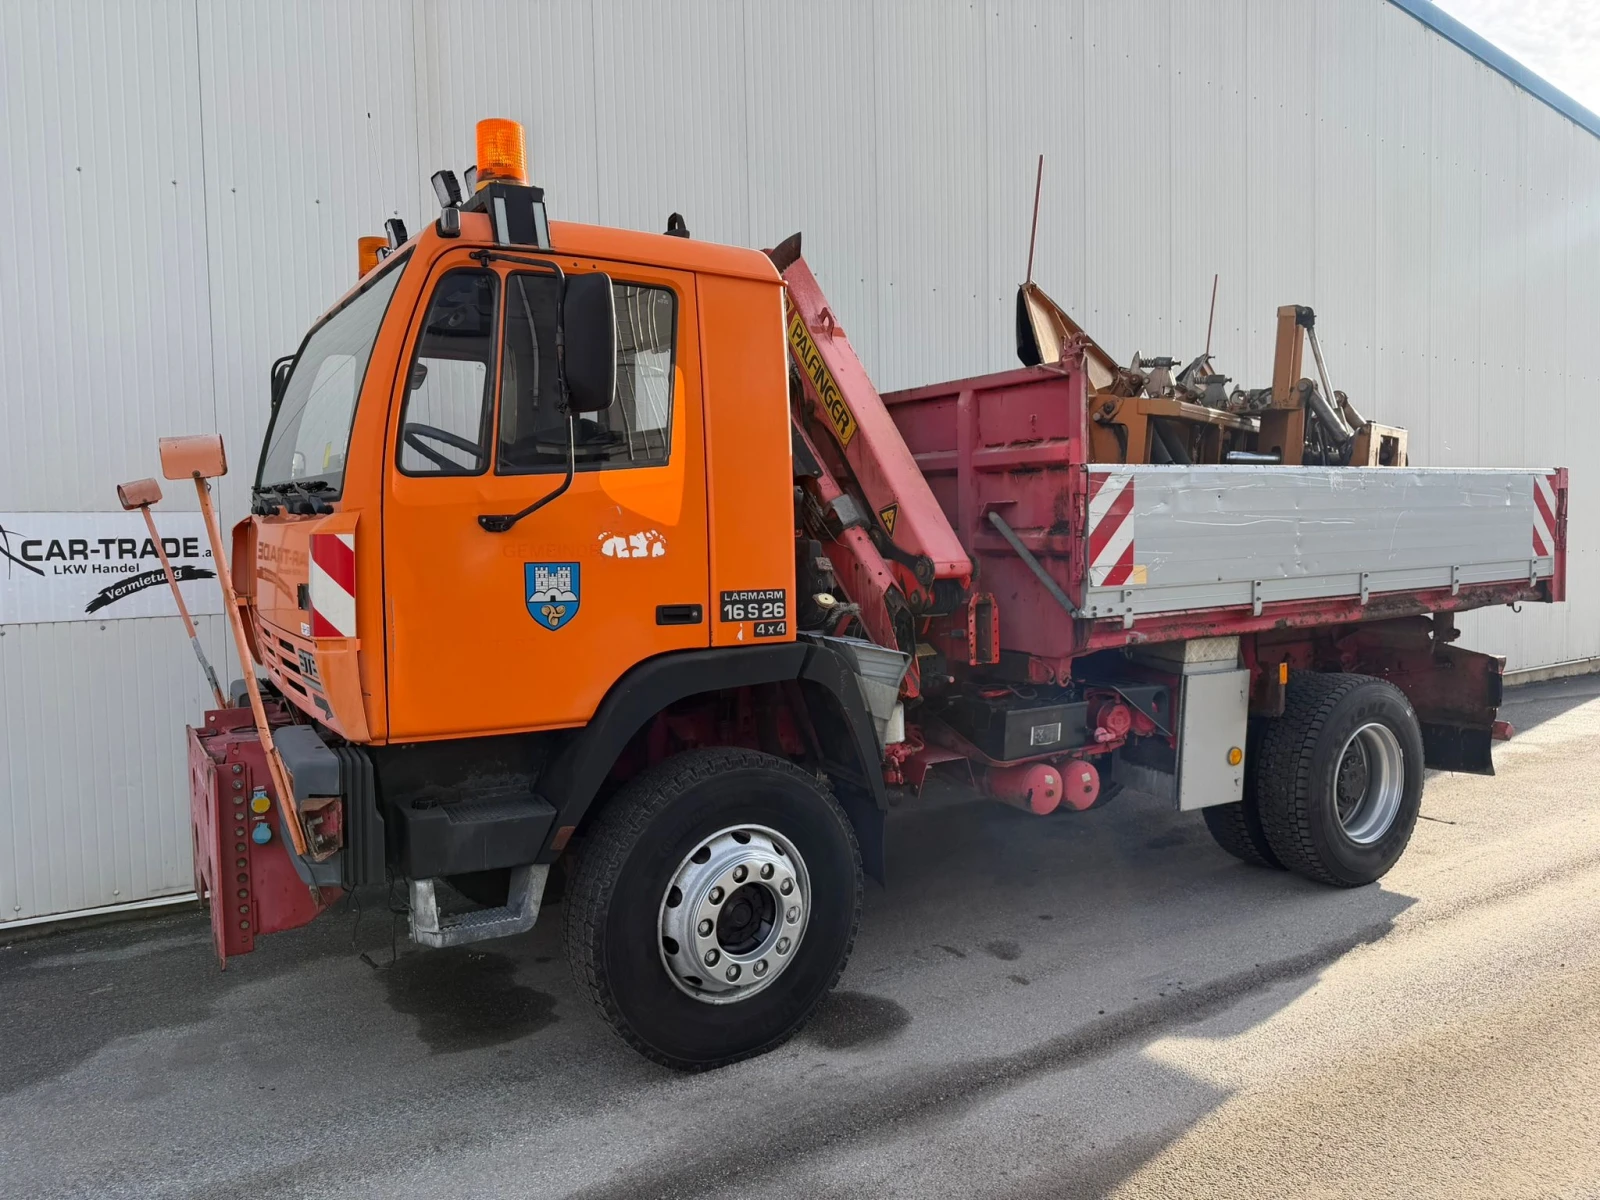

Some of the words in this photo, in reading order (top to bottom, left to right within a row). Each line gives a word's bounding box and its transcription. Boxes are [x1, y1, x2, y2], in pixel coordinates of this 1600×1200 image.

[791, 322, 851, 436] PALFINGER
[53, 564, 88, 575] LKW
[92, 562, 140, 574] Handel
[105, 569, 183, 600] Vermietug
[723, 604, 745, 620] 16
[747, 603, 759, 619] S
[761, 602, 785, 618] 26
